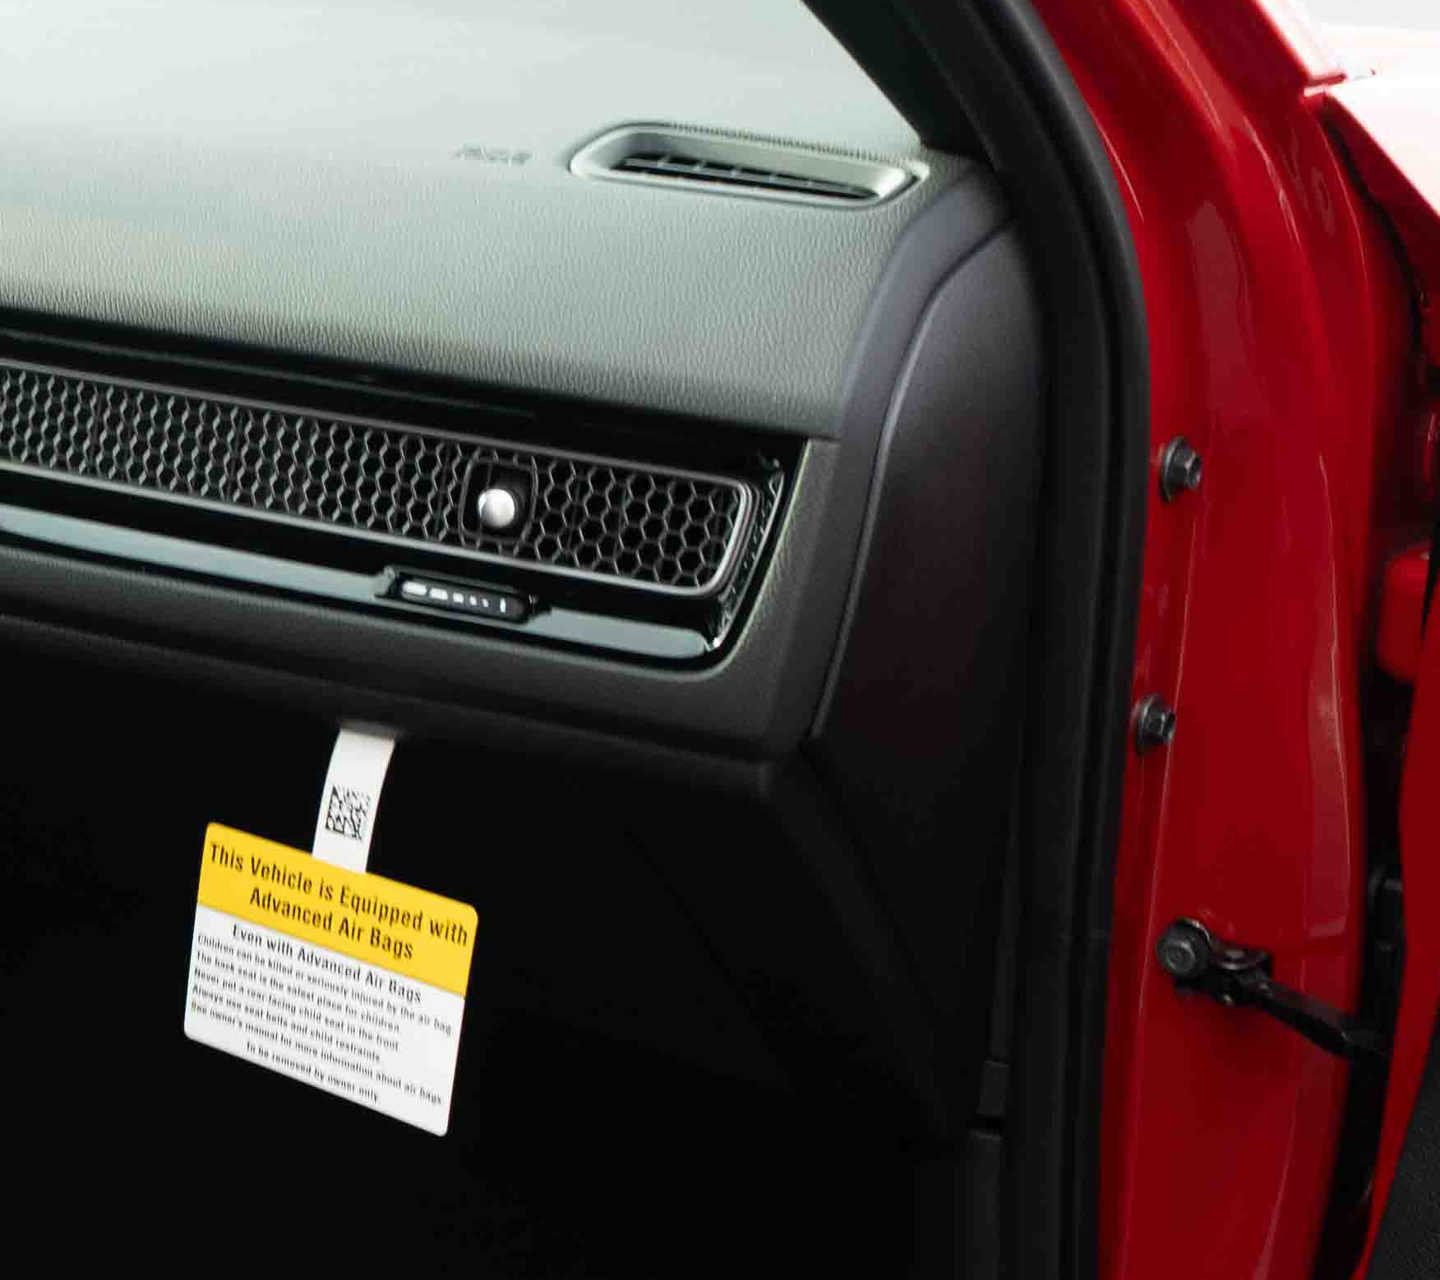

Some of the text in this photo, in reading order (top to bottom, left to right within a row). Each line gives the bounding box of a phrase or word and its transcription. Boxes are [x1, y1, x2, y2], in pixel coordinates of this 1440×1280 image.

[211, 843, 468, 947] This Vehicle is Equipped with
[249, 886, 414, 960] Advanced Air Bags
[232, 923, 422, 1004] Even with Advanced Air Bags
